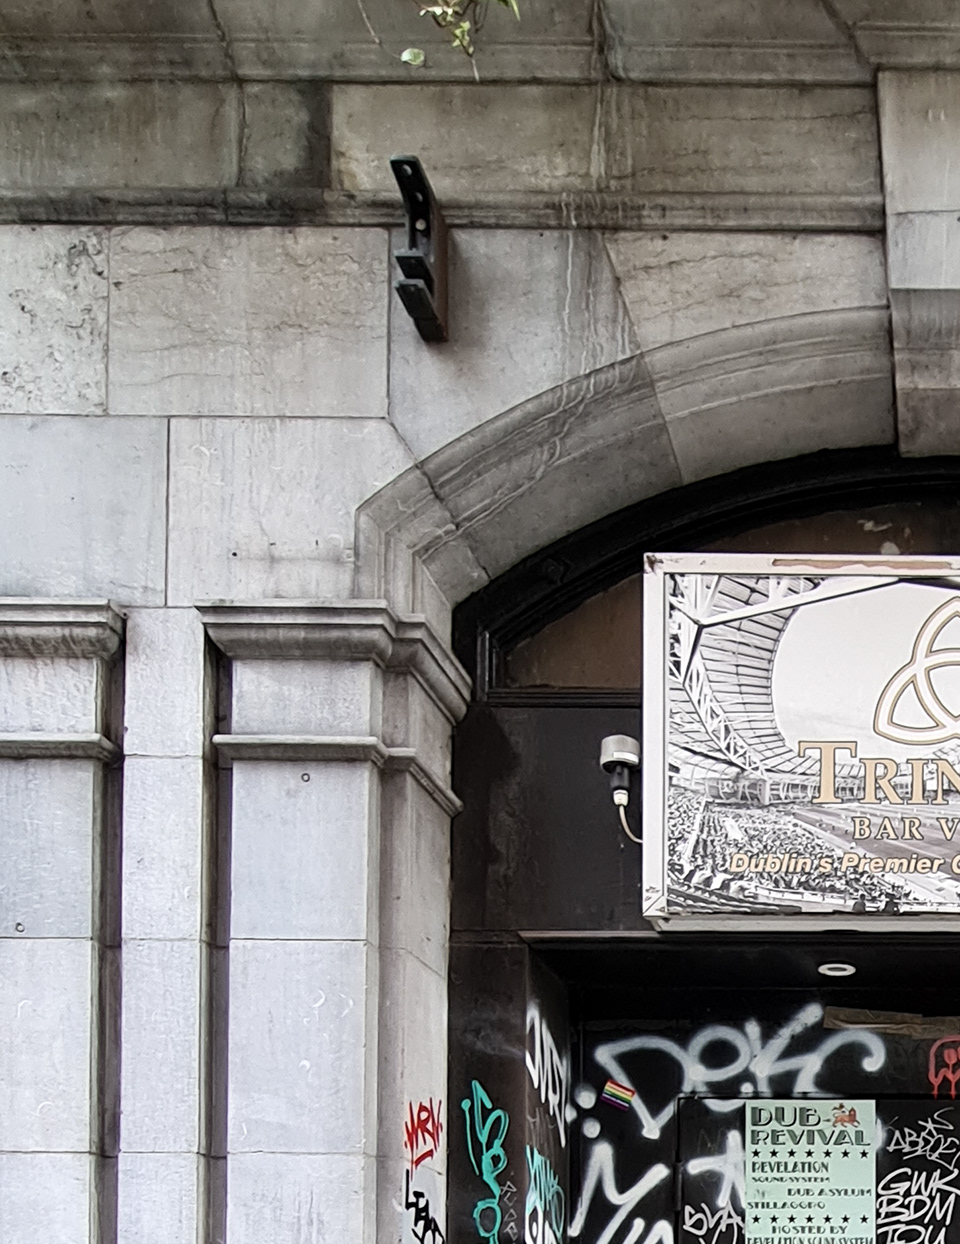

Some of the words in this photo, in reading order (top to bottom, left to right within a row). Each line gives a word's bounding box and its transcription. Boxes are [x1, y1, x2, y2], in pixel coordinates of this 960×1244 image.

[852, 816, 924, 842] BAR
[839, 852, 943, 877] Premier
[750, 1106, 822, 1128] DUB
[750, 1129, 871, 1147] REVIVAL
[752, 1161, 830, 1174] REVELATION
[771, 1225, 826, 1235] HOSTED
[829, 1225, 849, 1235] BY
